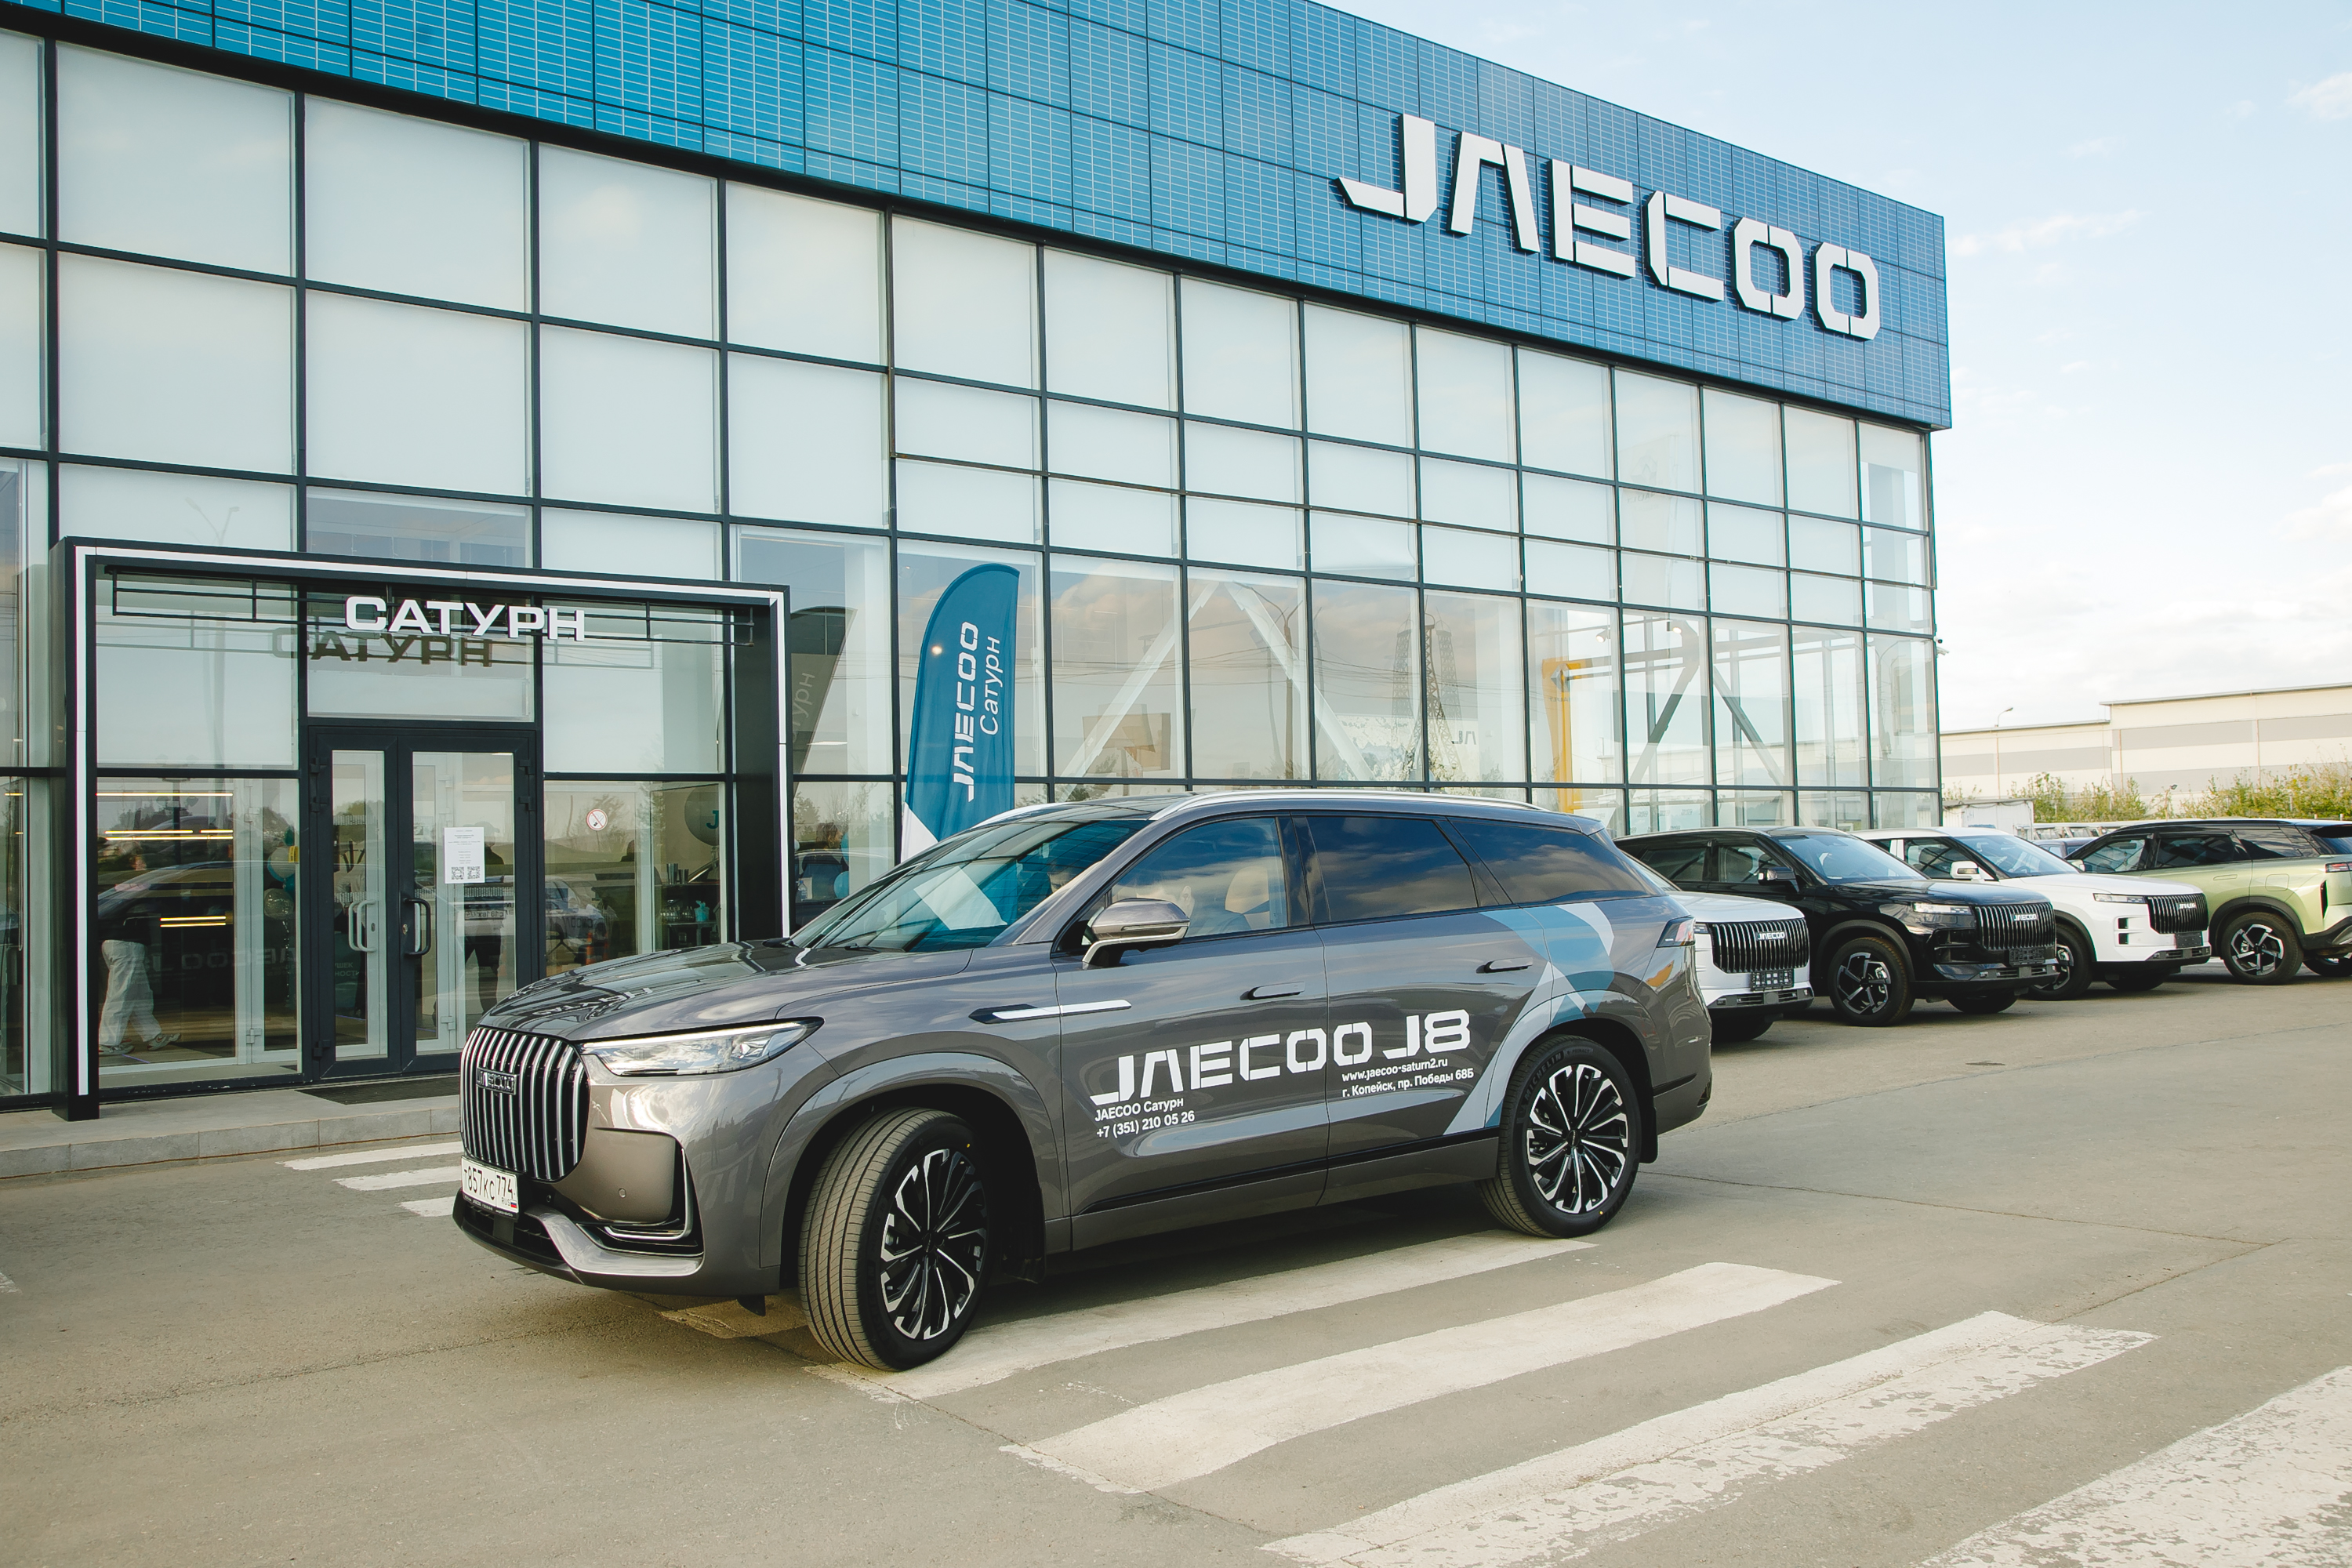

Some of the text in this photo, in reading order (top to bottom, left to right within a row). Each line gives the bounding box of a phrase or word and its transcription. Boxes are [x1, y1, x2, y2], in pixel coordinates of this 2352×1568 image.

[1335, 114, 1881, 341] JAECOO
[345, 596, 585, 641] САТУРН
[980, 636, 1004, 735] Сатурн
[953, 621, 978, 802] JAECOO
[1089, 1009, 1471, 1106] JAECOO J8
[1341, 1058, 1448, 1082] www.jaecoo-saturn2.ru
[1342, 1068, 1475, 1098] г. Копейск, пр. Победы 68Б
[1524, 1052, 1562, 1101] MICHELIN
[1094, 1098, 1184, 1122] JAECOO Сатурн
[1096, 1110, 1196, 1138] +7 (351) 210 05 26
[496, 1174, 513, 1199] 774
[502, 1196, 510, 1206] RUS
